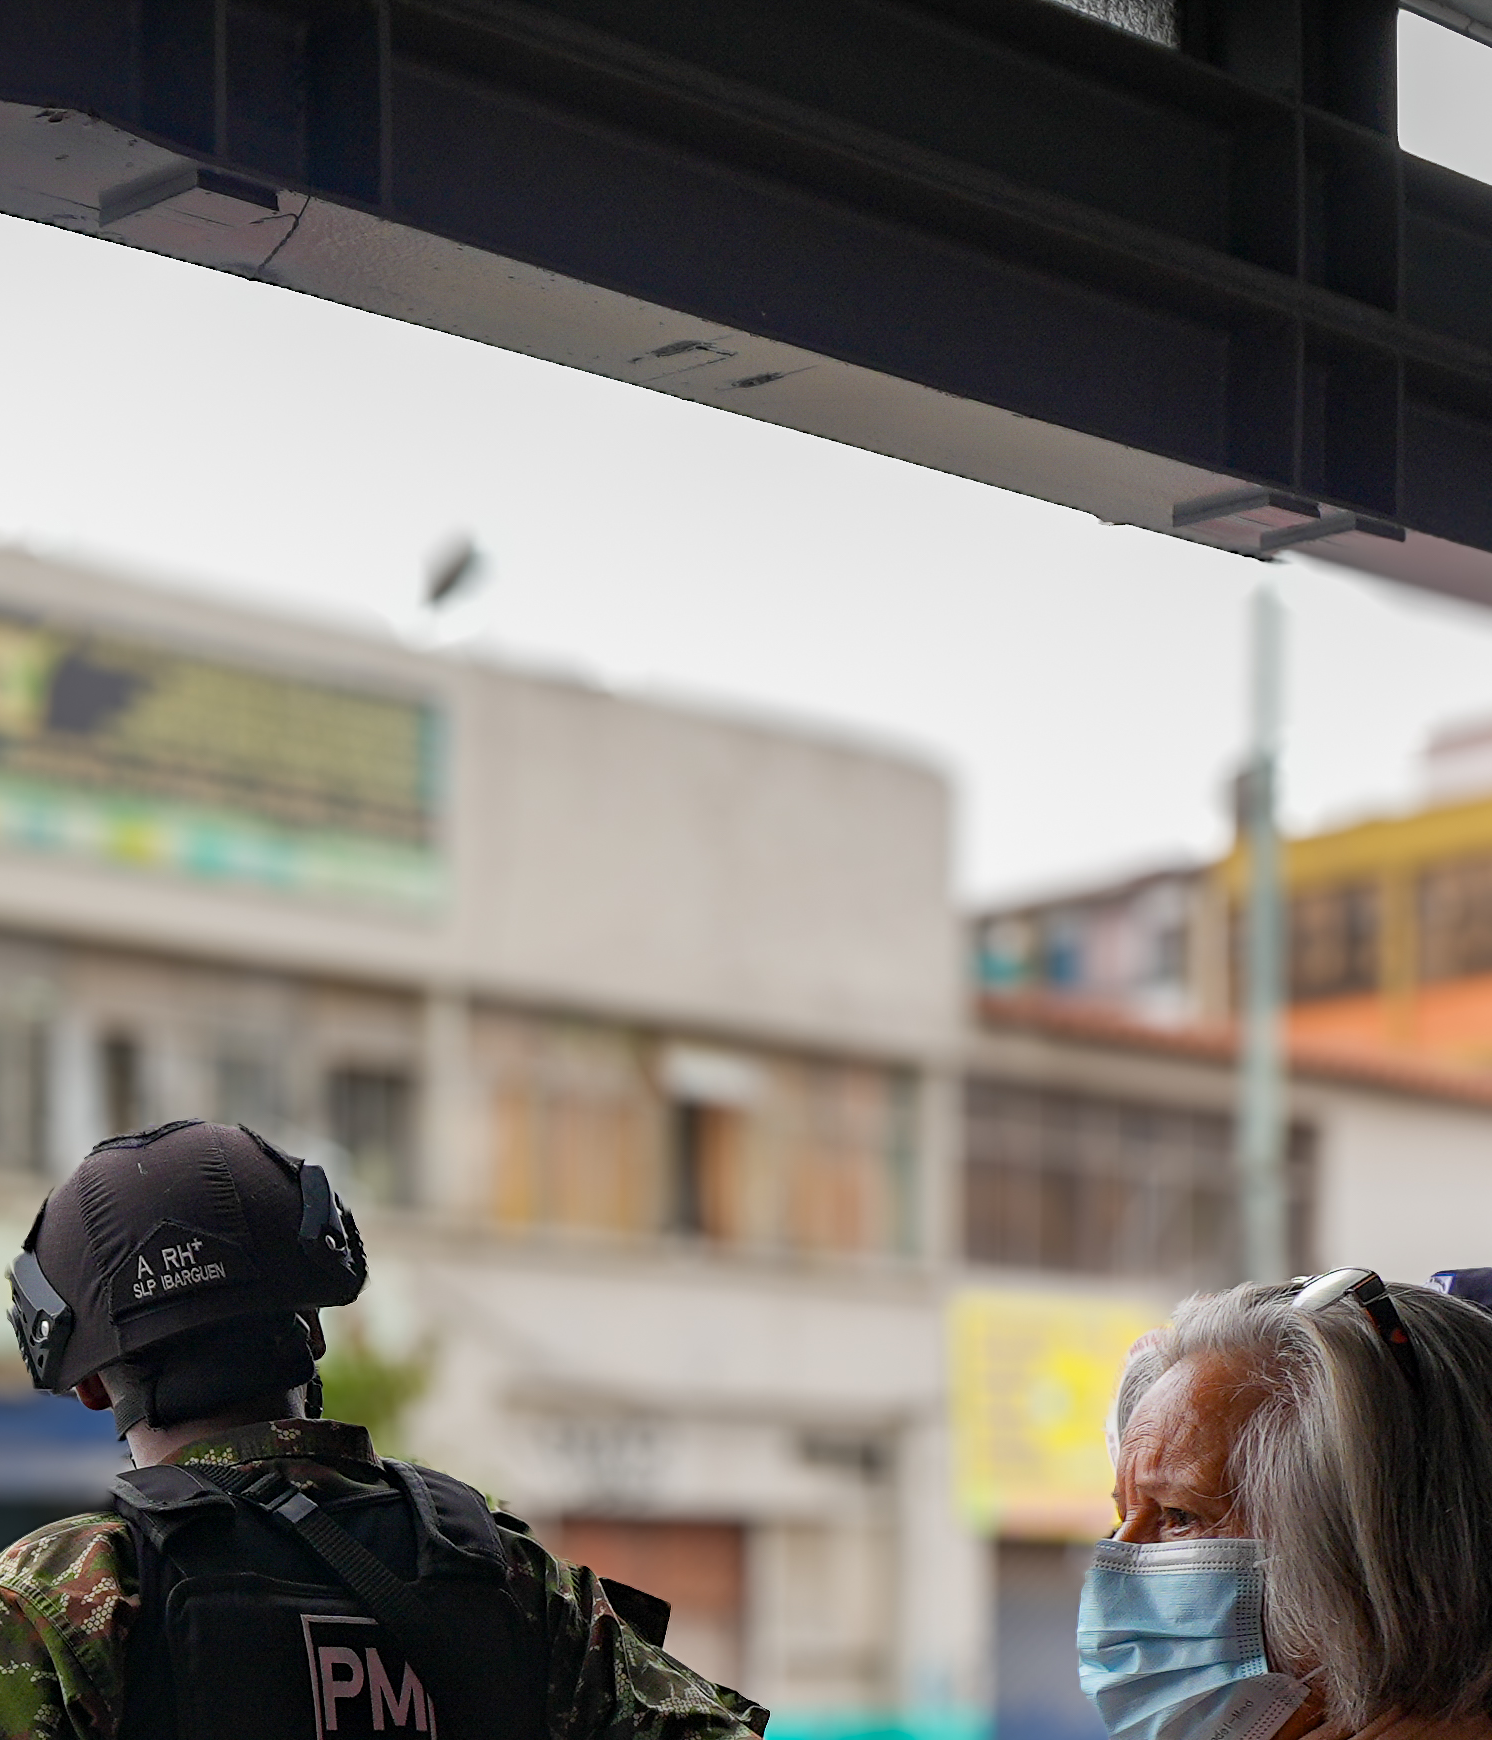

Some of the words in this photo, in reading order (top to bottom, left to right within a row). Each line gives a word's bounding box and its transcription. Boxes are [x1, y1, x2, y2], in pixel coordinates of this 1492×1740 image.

[133, 1279, 157, 1300] SLP
[160, 1262, 227, 1291] IBARGUEN
[137, 1254, 155, 1280] A
[318, 1646, 428, 1732] PM
